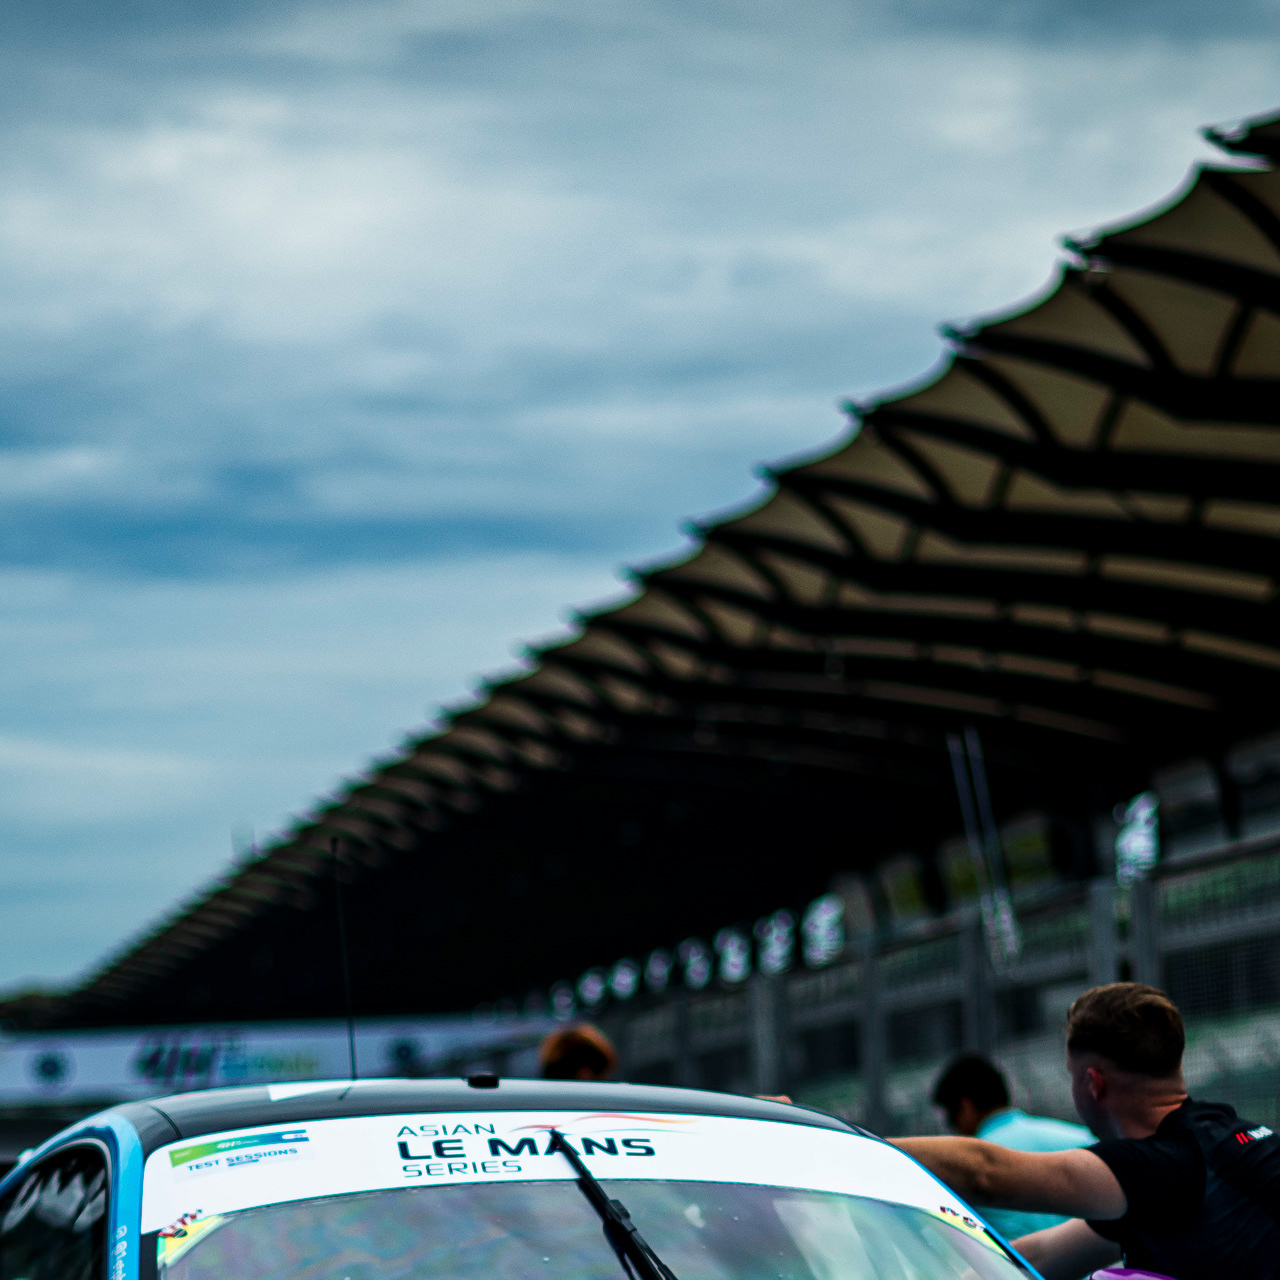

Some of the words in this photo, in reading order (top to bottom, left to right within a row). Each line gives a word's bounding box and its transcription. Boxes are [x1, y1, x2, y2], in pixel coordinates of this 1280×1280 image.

[397, 1123, 496, 1138] ASIAN
[397, 1138, 467, 1160] LE
[487, 1137, 656, 1157] MANS
[186, 1158, 220, 1171] TEST
[226, 1147, 298, 1163] SESSIONS
[402, 1160, 523, 1178] SERIES
